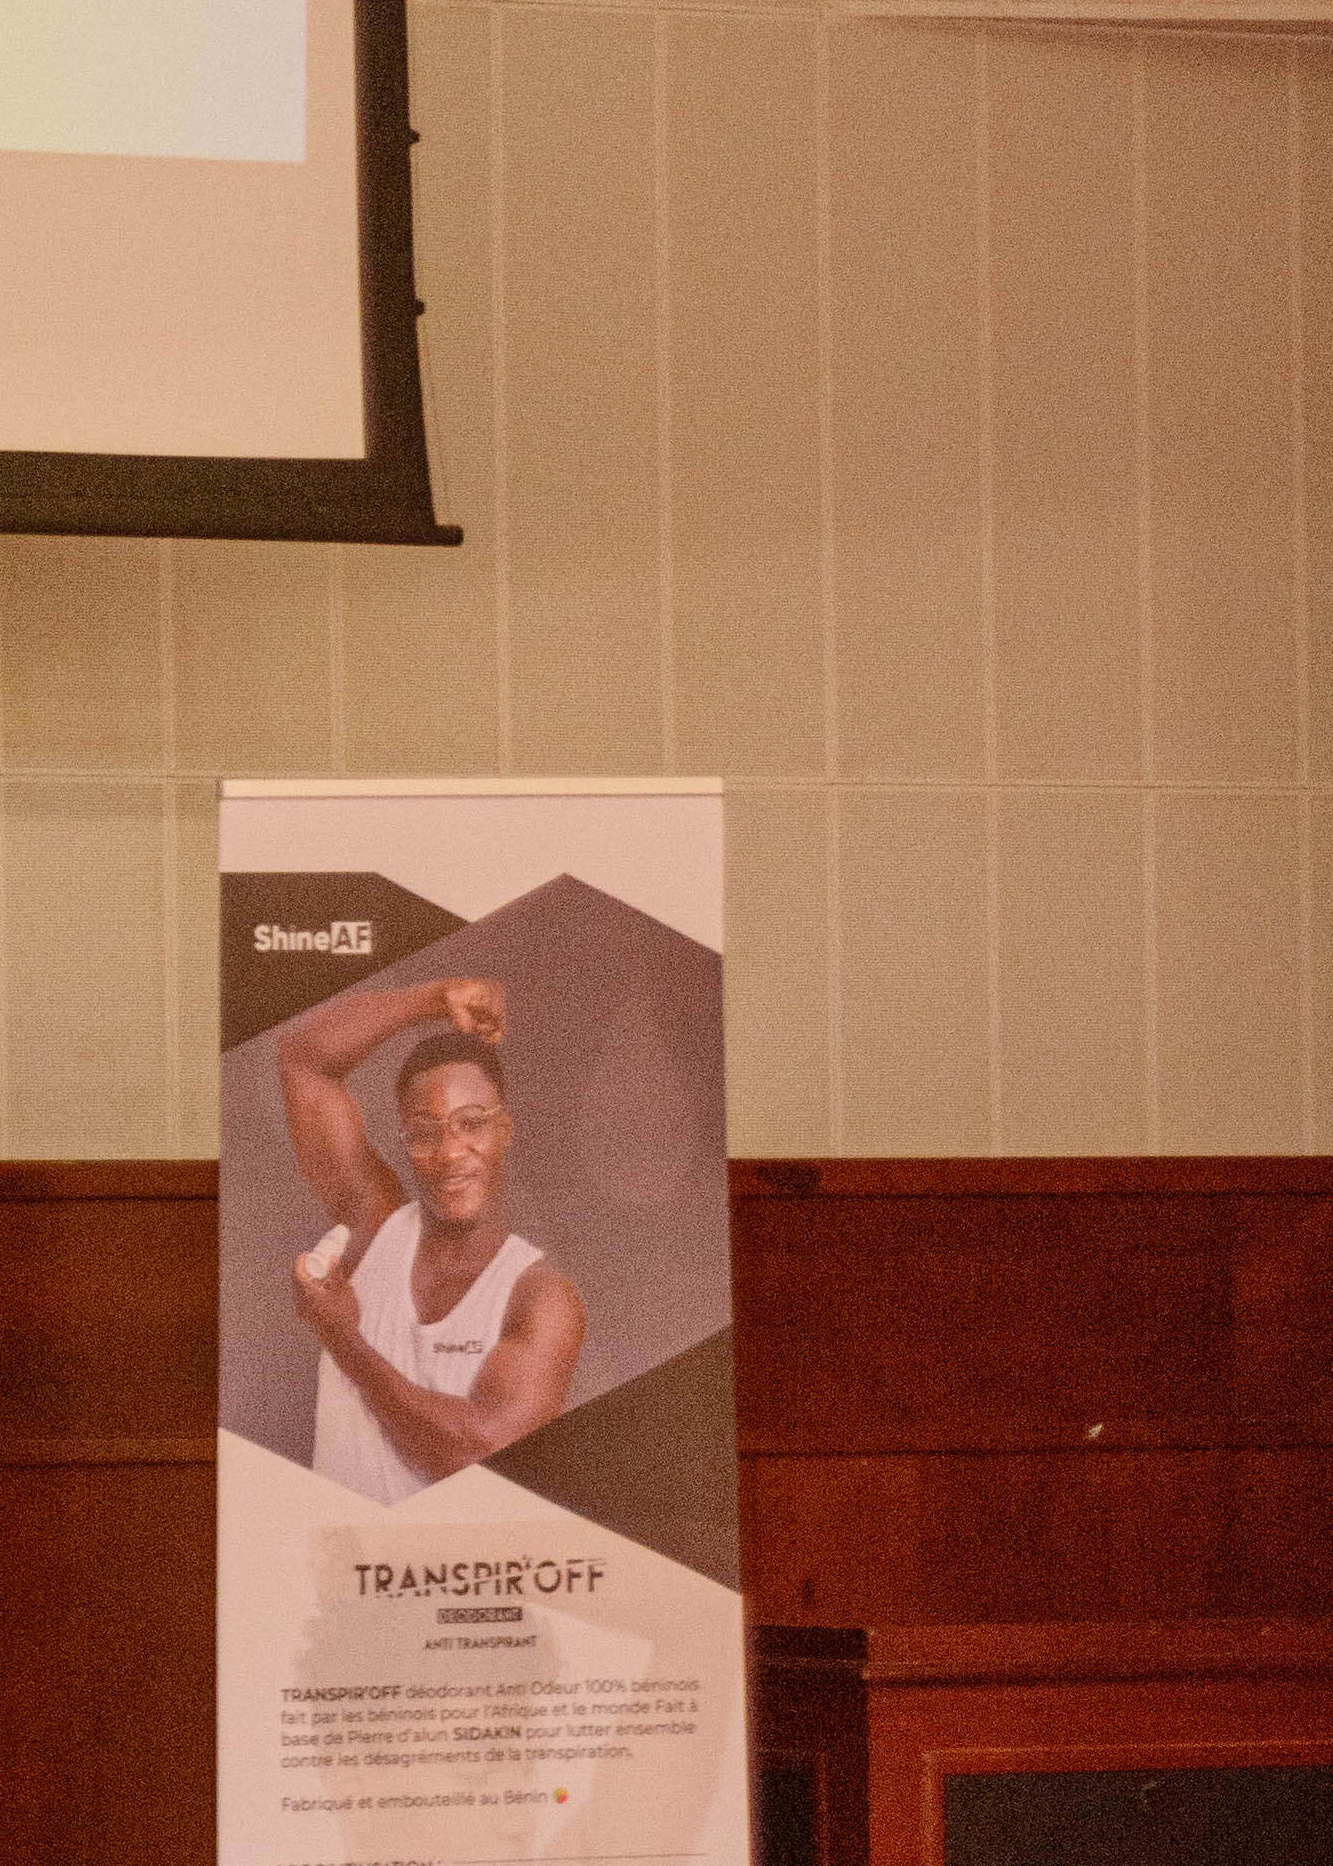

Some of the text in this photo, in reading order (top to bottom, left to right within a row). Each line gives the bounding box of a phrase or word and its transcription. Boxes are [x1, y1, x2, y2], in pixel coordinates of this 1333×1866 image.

[531, 1680, 581, 1695] Odeur
[585, 1679, 628, 1694] 100%
[311, 1711, 336, 1727] par
[440, 1707, 480, 1723] pour
[551, 1703, 569, 1716] et
[572, 1702, 587, 1715] le
[591, 1701, 651, 1715] monde
[281, 1731, 318, 1746] base
[322, 1731, 343, 1745] de
[525, 1726, 564, 1741] pour
[616, 1721, 696, 1736] ensemble
[281, 1754, 334, 1768] contre
[484, 1747, 504, 1762] de
[357, 1794, 373, 1809] et
